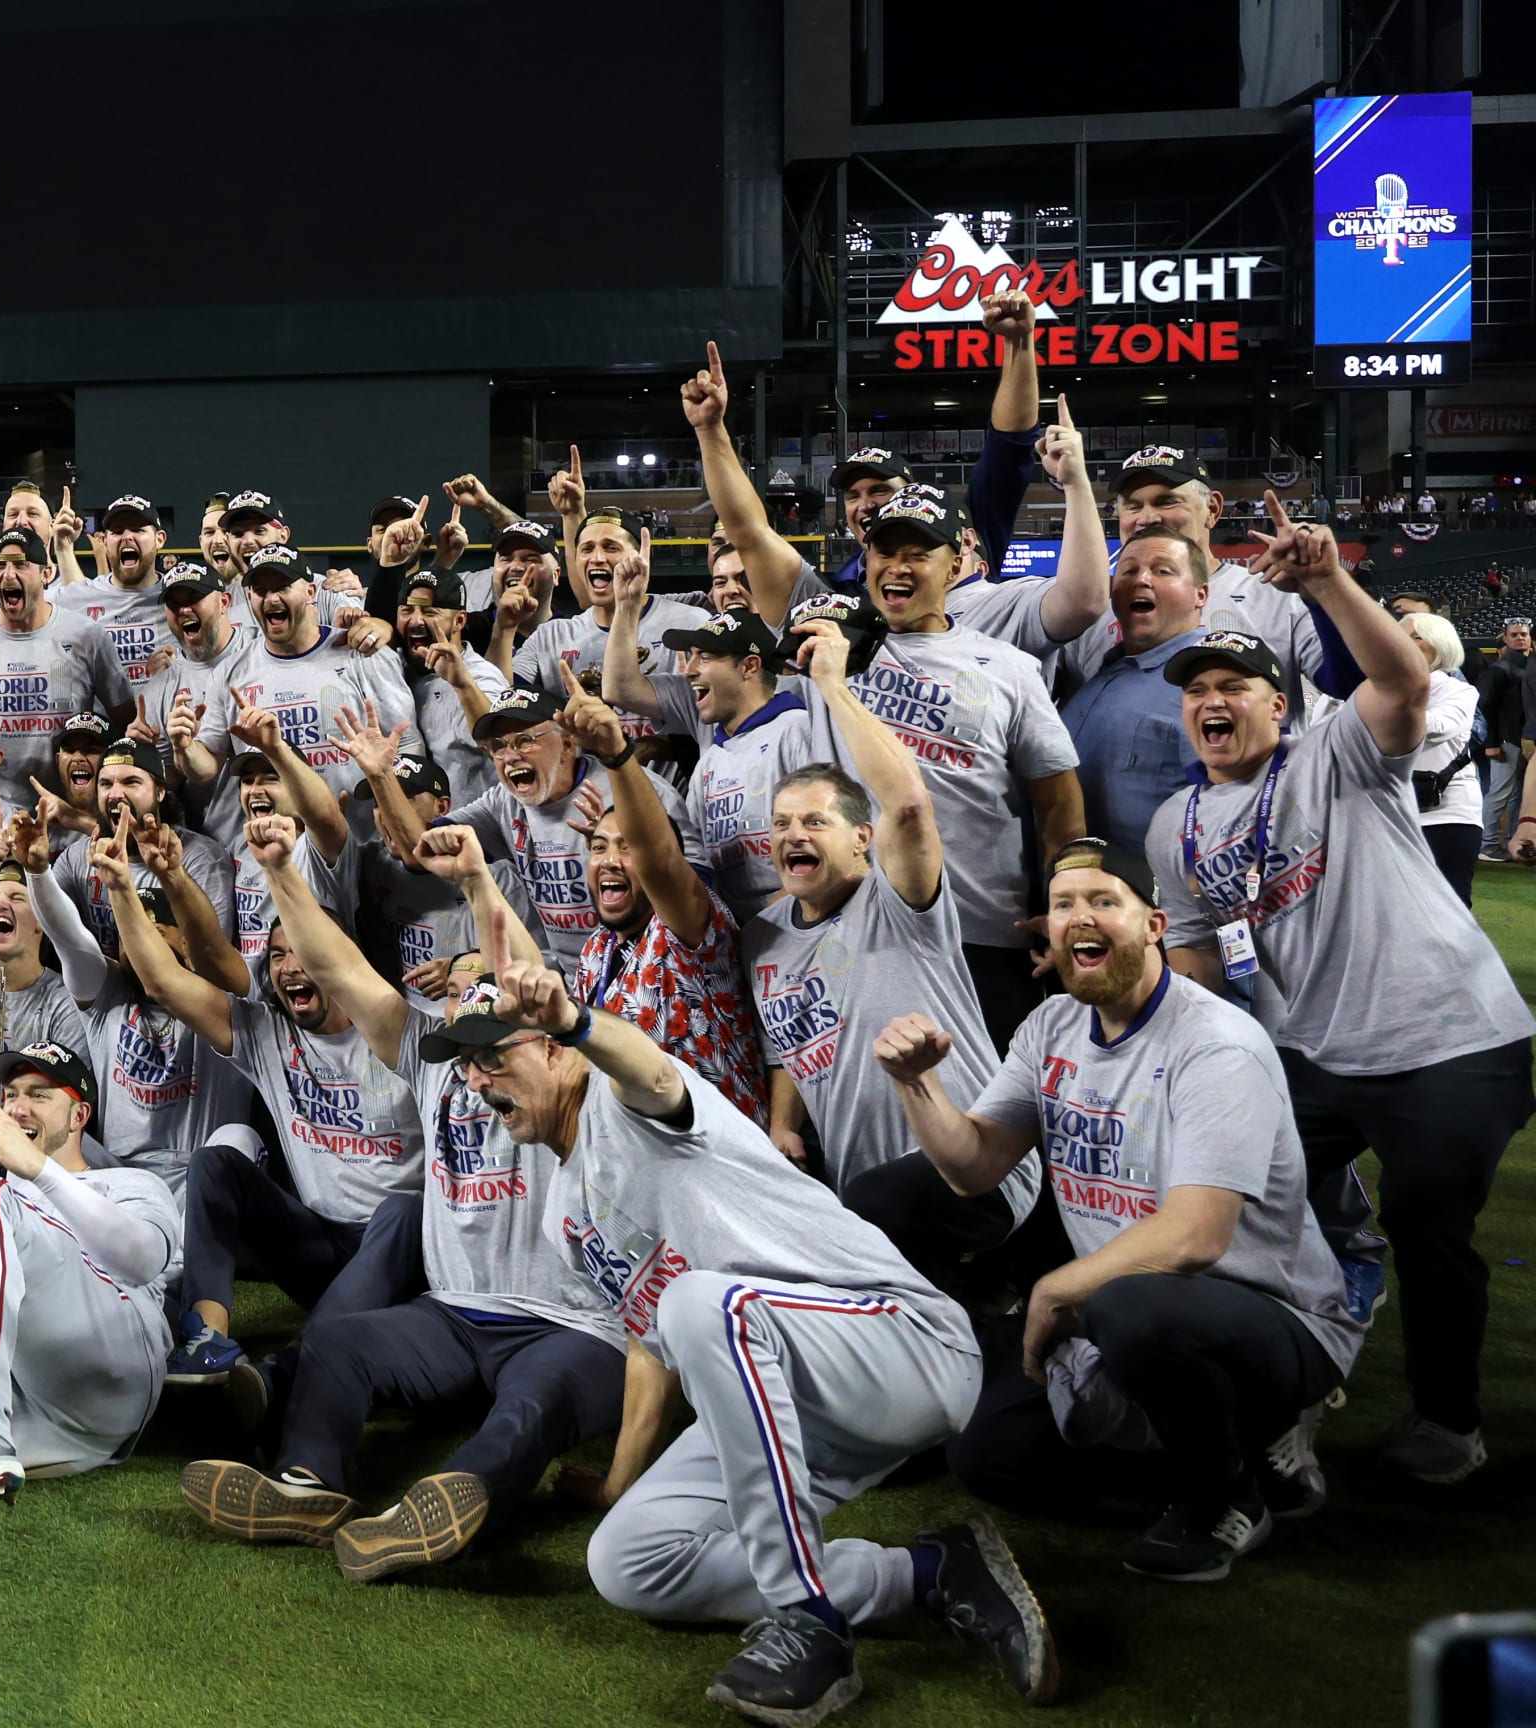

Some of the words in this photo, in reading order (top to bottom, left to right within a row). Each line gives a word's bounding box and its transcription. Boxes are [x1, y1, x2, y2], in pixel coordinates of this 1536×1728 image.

[1328, 216, 1458, 237] CHAMPIONS
[1335, 211, 1381, 219] WORLD
[1404, 208, 1449, 217] SERIES
[1355, 237, 1376, 248] 20
[1408, 235, 1429, 247] 23
[892, 244, 1086, 312] Coors
[1091, 256, 1263, 305] LIGHT
[1090, 321, 1240, 365] ZONE
[1344, 355, 1399, 377] 8:34
[1405, 354, 1443, 376] PM
[854, 661, 953, 709] WORLD
[516, 855, 583, 881] WORLD
[755, 963, 778, 1001] T
[761, 975, 827, 1028] WORLD
[767, 1000, 840, 1053] SERIES
[284, 1067, 360, 1113] WORLD
[1040, 1055, 1077, 1100] T
[290, 1116, 405, 1159] CHAMPIONS
[1042, 1100, 1125, 1148] WORLD
